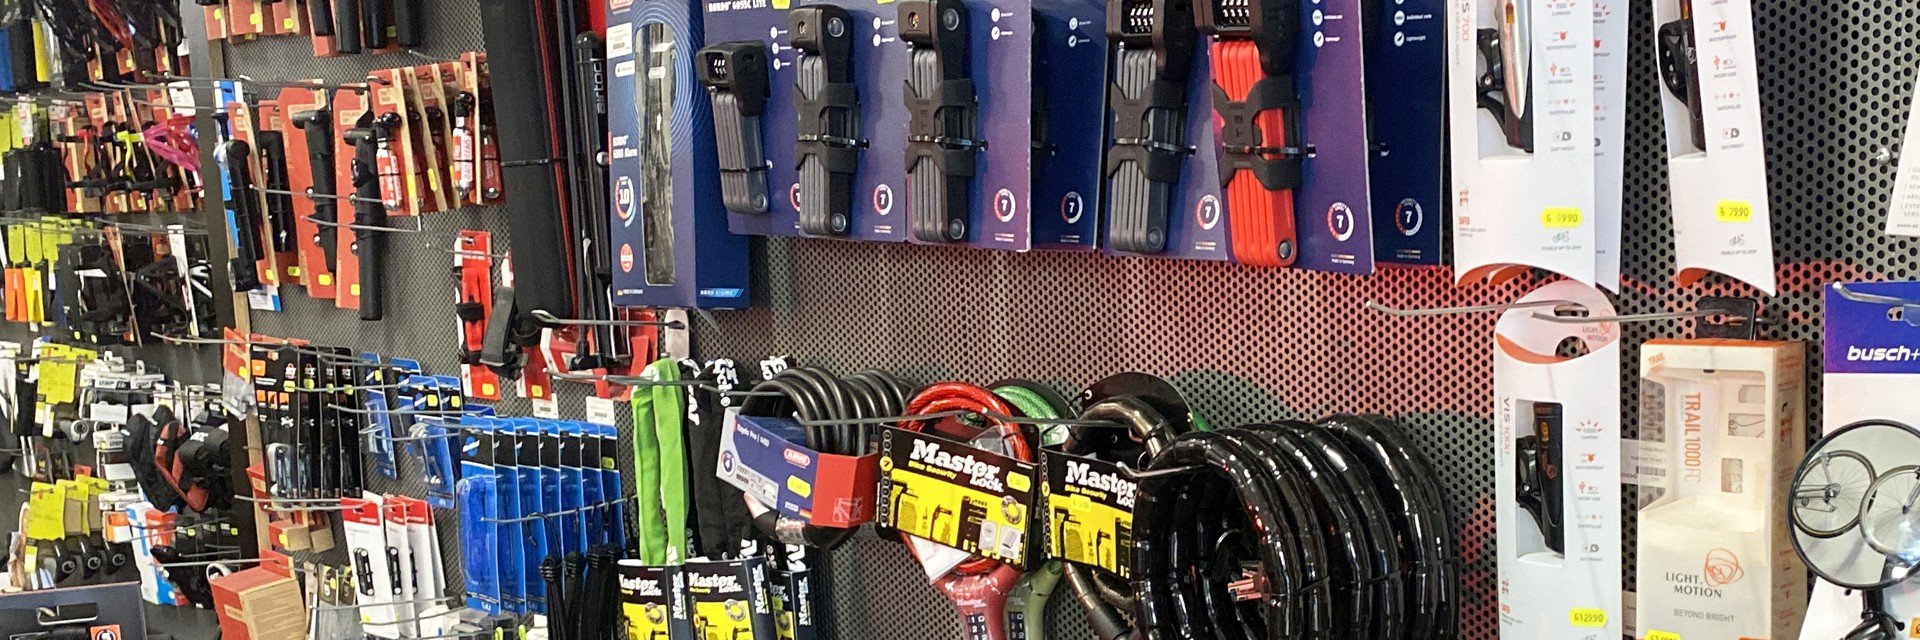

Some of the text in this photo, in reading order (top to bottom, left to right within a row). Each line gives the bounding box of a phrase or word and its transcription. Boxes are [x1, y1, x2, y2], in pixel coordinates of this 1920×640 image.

[1205, 206, 1212, 218] 7
[1405, 211, 1412, 223] 7
[1336, 215, 1344, 228] 7
[1685, 393, 1701, 435] TRAIL
[909, 438, 1000, 480] Master
[970, 474, 1004, 493] Lock
[1065, 460, 1137, 496] Master
[689, 573, 737, 589] Master
[1665, 572, 1699, 584] LIGHT
[640, 587, 662, 597] Lock
[672, 571, 684, 619] Master
[719, 584, 743, 594] Lock
[753, 564, 767, 614] Master
[1674, 585, 1722, 598] MOTION
[1674, 608, 1735, 623] BEYOND BRIGHT
